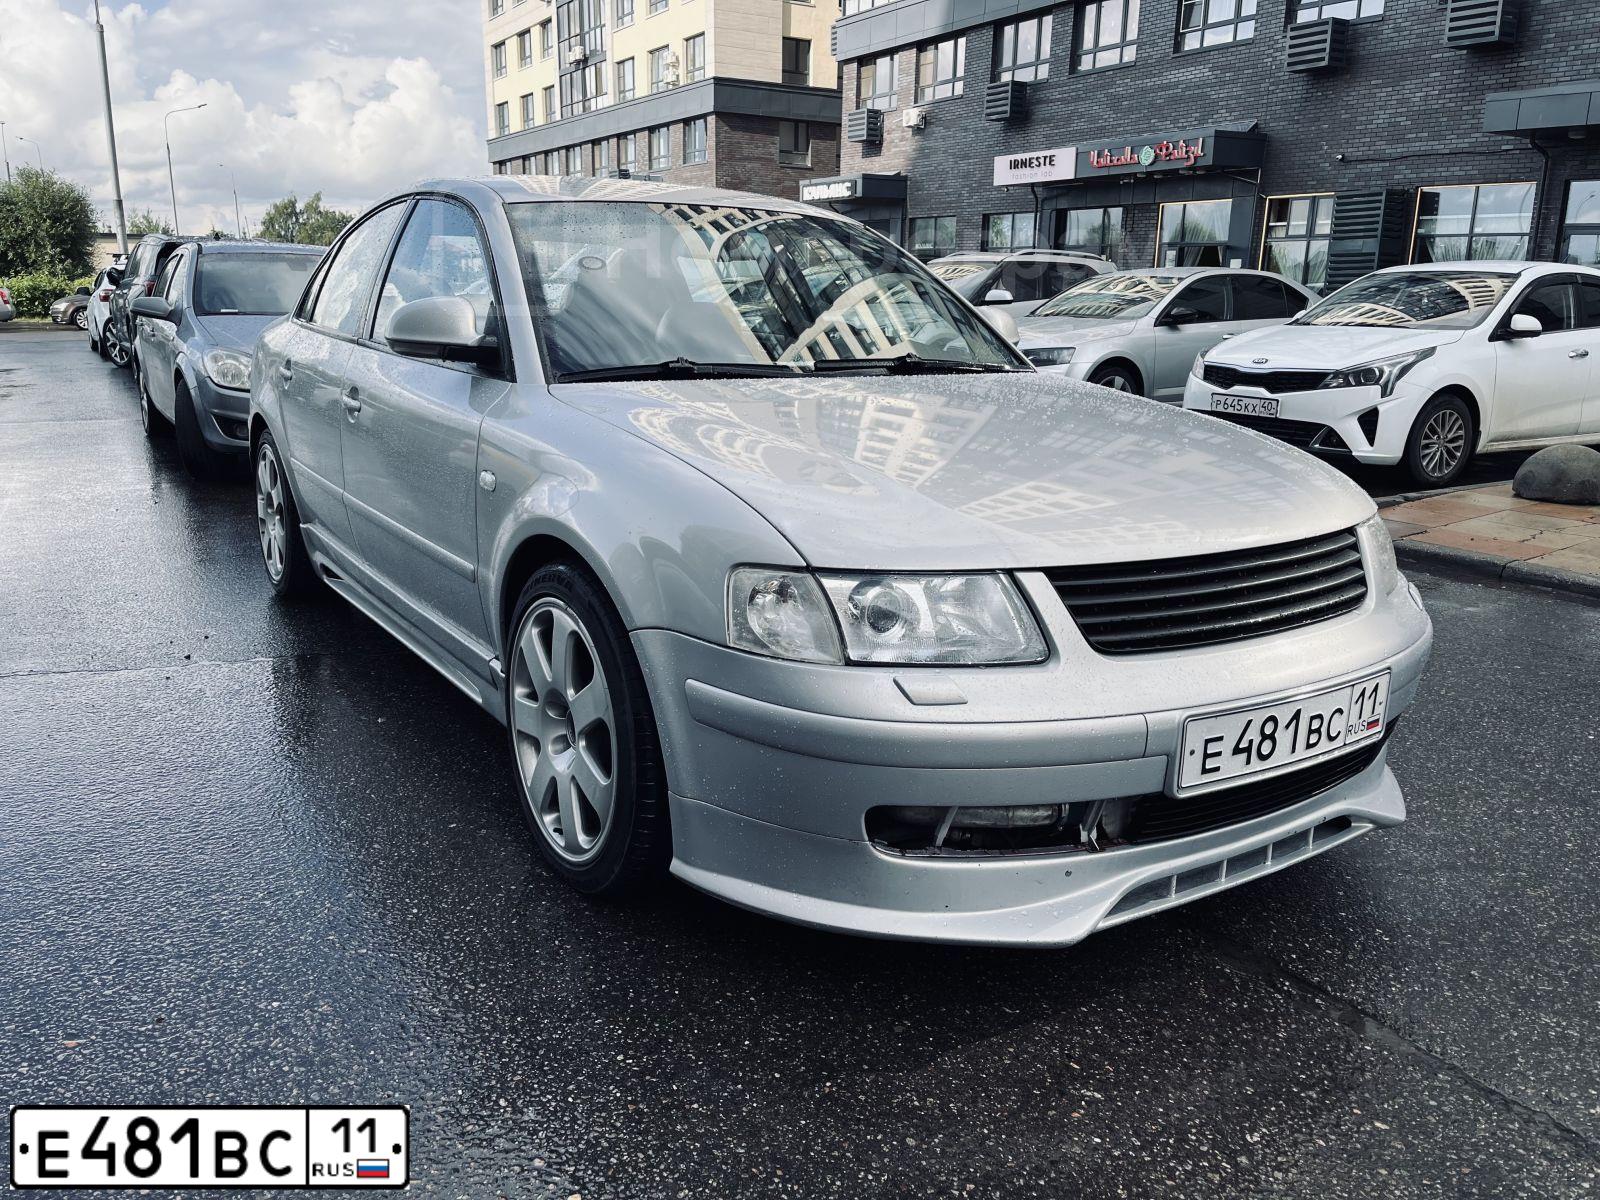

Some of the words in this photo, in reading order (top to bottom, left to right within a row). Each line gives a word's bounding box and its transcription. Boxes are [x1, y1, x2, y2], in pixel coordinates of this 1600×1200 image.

[1009, 154, 1057, 170] IRNESTE
[1012, 171, 1038, 180] fashion
[1041, 170, 1053, 178] lab
[1261, 401, 1273, 411] 40
[1355, 682, 1380, 720] 11
[1346, 720, 1367, 738] RUS
